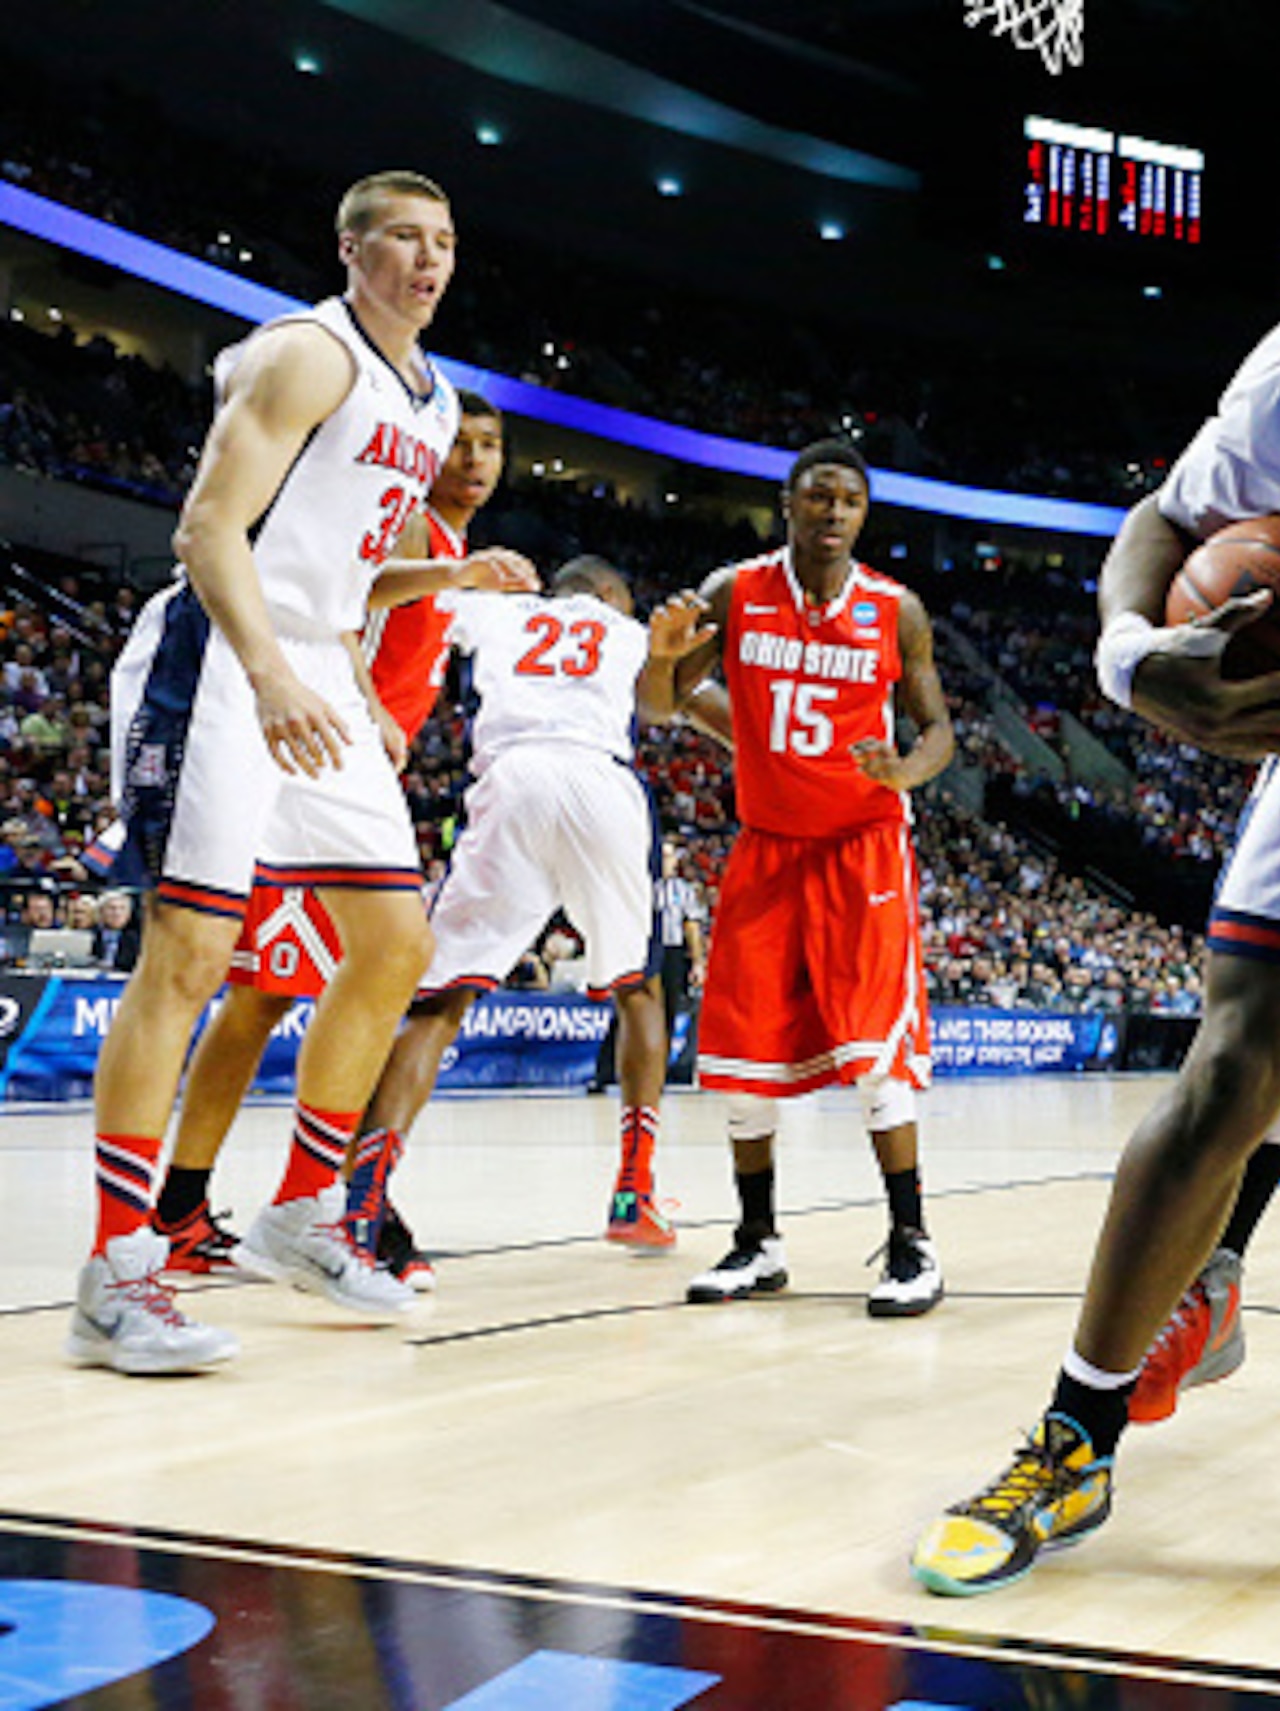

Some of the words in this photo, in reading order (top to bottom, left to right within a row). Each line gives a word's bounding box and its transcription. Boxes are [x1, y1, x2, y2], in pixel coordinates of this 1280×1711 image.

[514, 612, 607, 678] 23
[739, 630, 802, 673] OHIO
[803, 641, 881, 684] STATE
[769, 678, 838, 757] 15
